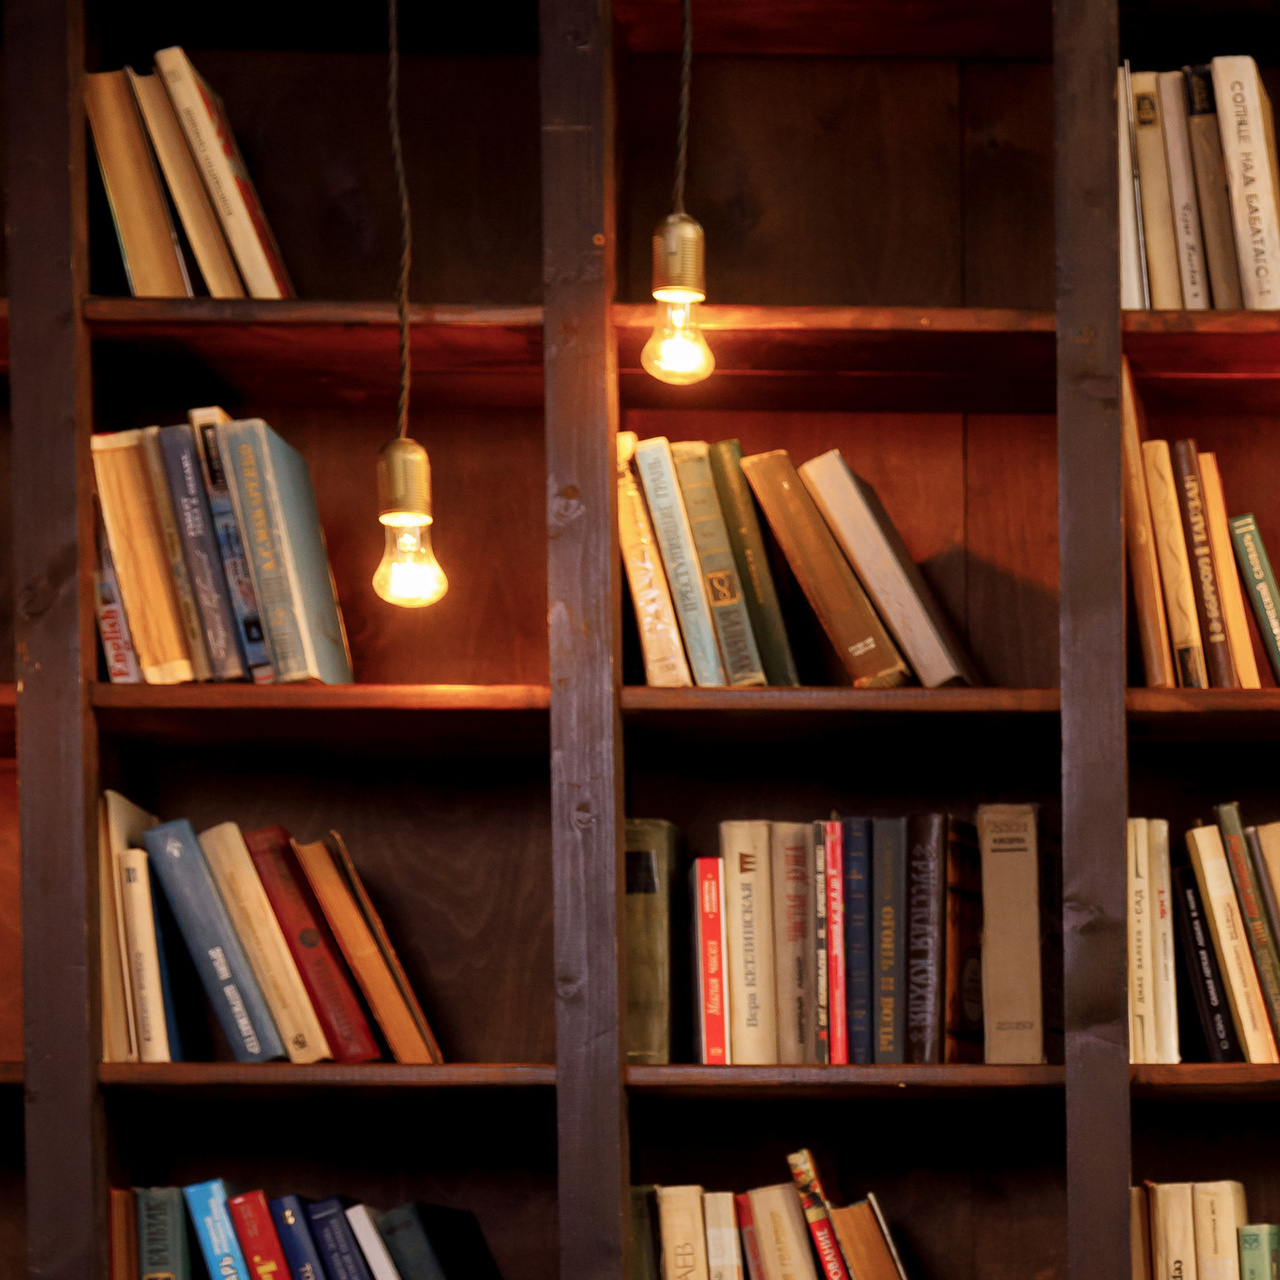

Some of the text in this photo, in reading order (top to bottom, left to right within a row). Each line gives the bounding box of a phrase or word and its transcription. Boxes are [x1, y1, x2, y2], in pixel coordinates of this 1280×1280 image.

[1238, 151, 1257, 186] НАД
[98, 607, 131, 679] English
[907, 860, 931, 1026] РУССКАЯ КУХНЯ
[745, 993, 760, 1027] Вера
